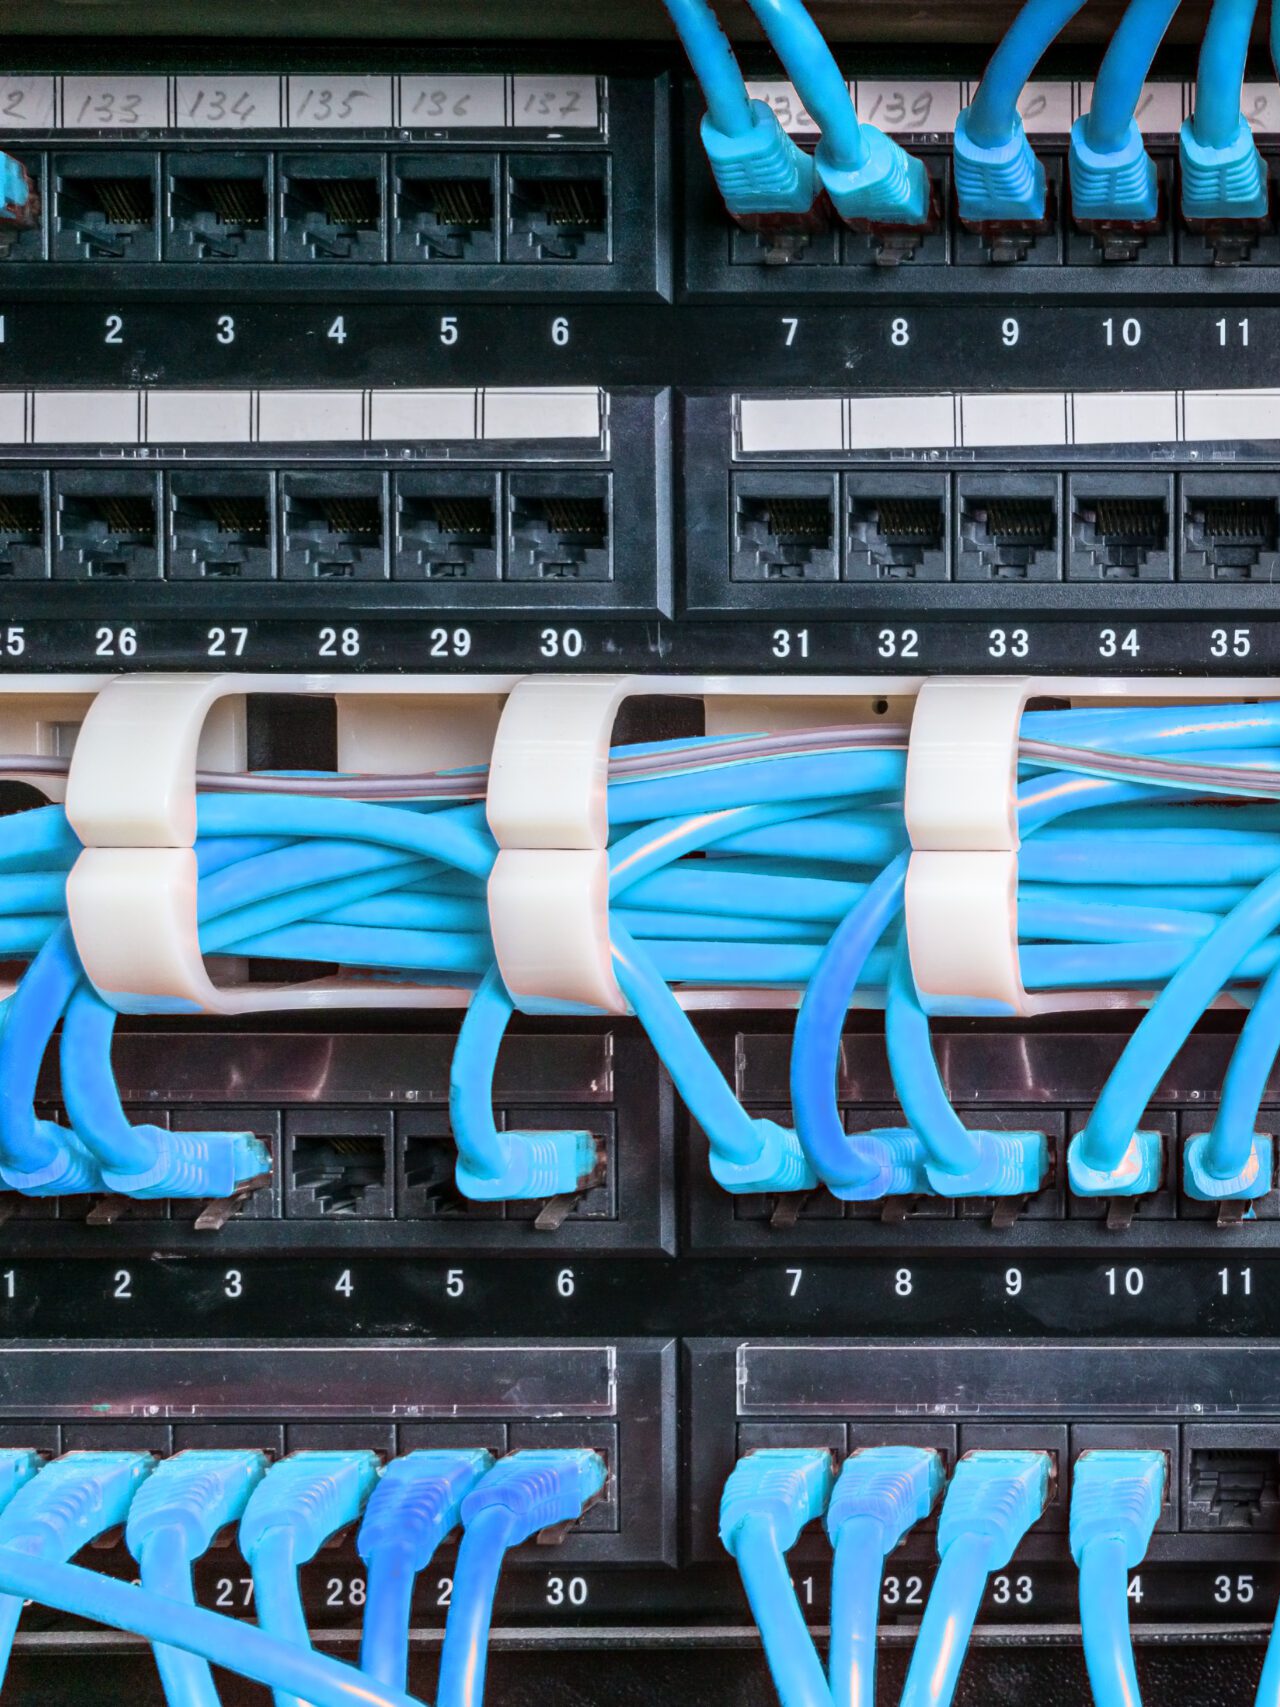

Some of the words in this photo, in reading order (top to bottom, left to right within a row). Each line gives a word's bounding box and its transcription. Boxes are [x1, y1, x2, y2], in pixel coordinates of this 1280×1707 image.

[76, 93, 143, 124] 133
[188, 90, 257, 125] 134
[296, 89, 371, 121] 135
[105, 315, 123, 344] 2
[216, 315, 235, 344] 3
[327, 316, 347, 344] 4
[440, 317, 458, 345] 5
[551, 317, 569, 346] 6
[781, 318, 799, 346] 7
[891, 317, 910, 346] 8
[1001, 317, 1020, 346] 9
[1102, 317, 1142, 347] 10
[1215, 317, 1249, 347] 11
[0, 627, 25, 656] 5
[95, 627, 138, 657] 26
[207, 627, 248, 657] 27
[318, 627, 360, 657] 28
[429, 628, 472, 657] 29
[539, 628, 583, 658] 30
[772, 628, 809, 658] 31
[877, 628, 919, 658] 32
[988, 628, 1030, 658] 33
[1098, 628, 1141, 658] 34
[1210, 628, 1251, 658] 35
[3, 1270, 15, 1298] 1
[114, 1269, 132, 1298] 2
[224, 1269, 243, 1298] 3
[334, 1269, 354, 1298] 4
[446, 1269, 464, 1297] 5
[557, 1268, 575, 1297] 6
[785, 1268, 803, 1297] 7
[894, 1268, 913, 1296] 8
[1005, 1267, 1022, 1296] 9
[1105, 1267, 1144, 1296] 10
[1217, 1267, 1251, 1295] 11
[215, 1577, 255, 1606] 27
[326, 1577, 367, 1606] 28
[436, 1577, 454, 1606] 2
[546, 1576, 588, 1606] 30
[882, 1575, 923, 1604] 32
[992, 1575, 1033, 1604] 33
[1126, 1575, 1144, 1604] 4
[1214, 1575, 1254, 1603] 35
